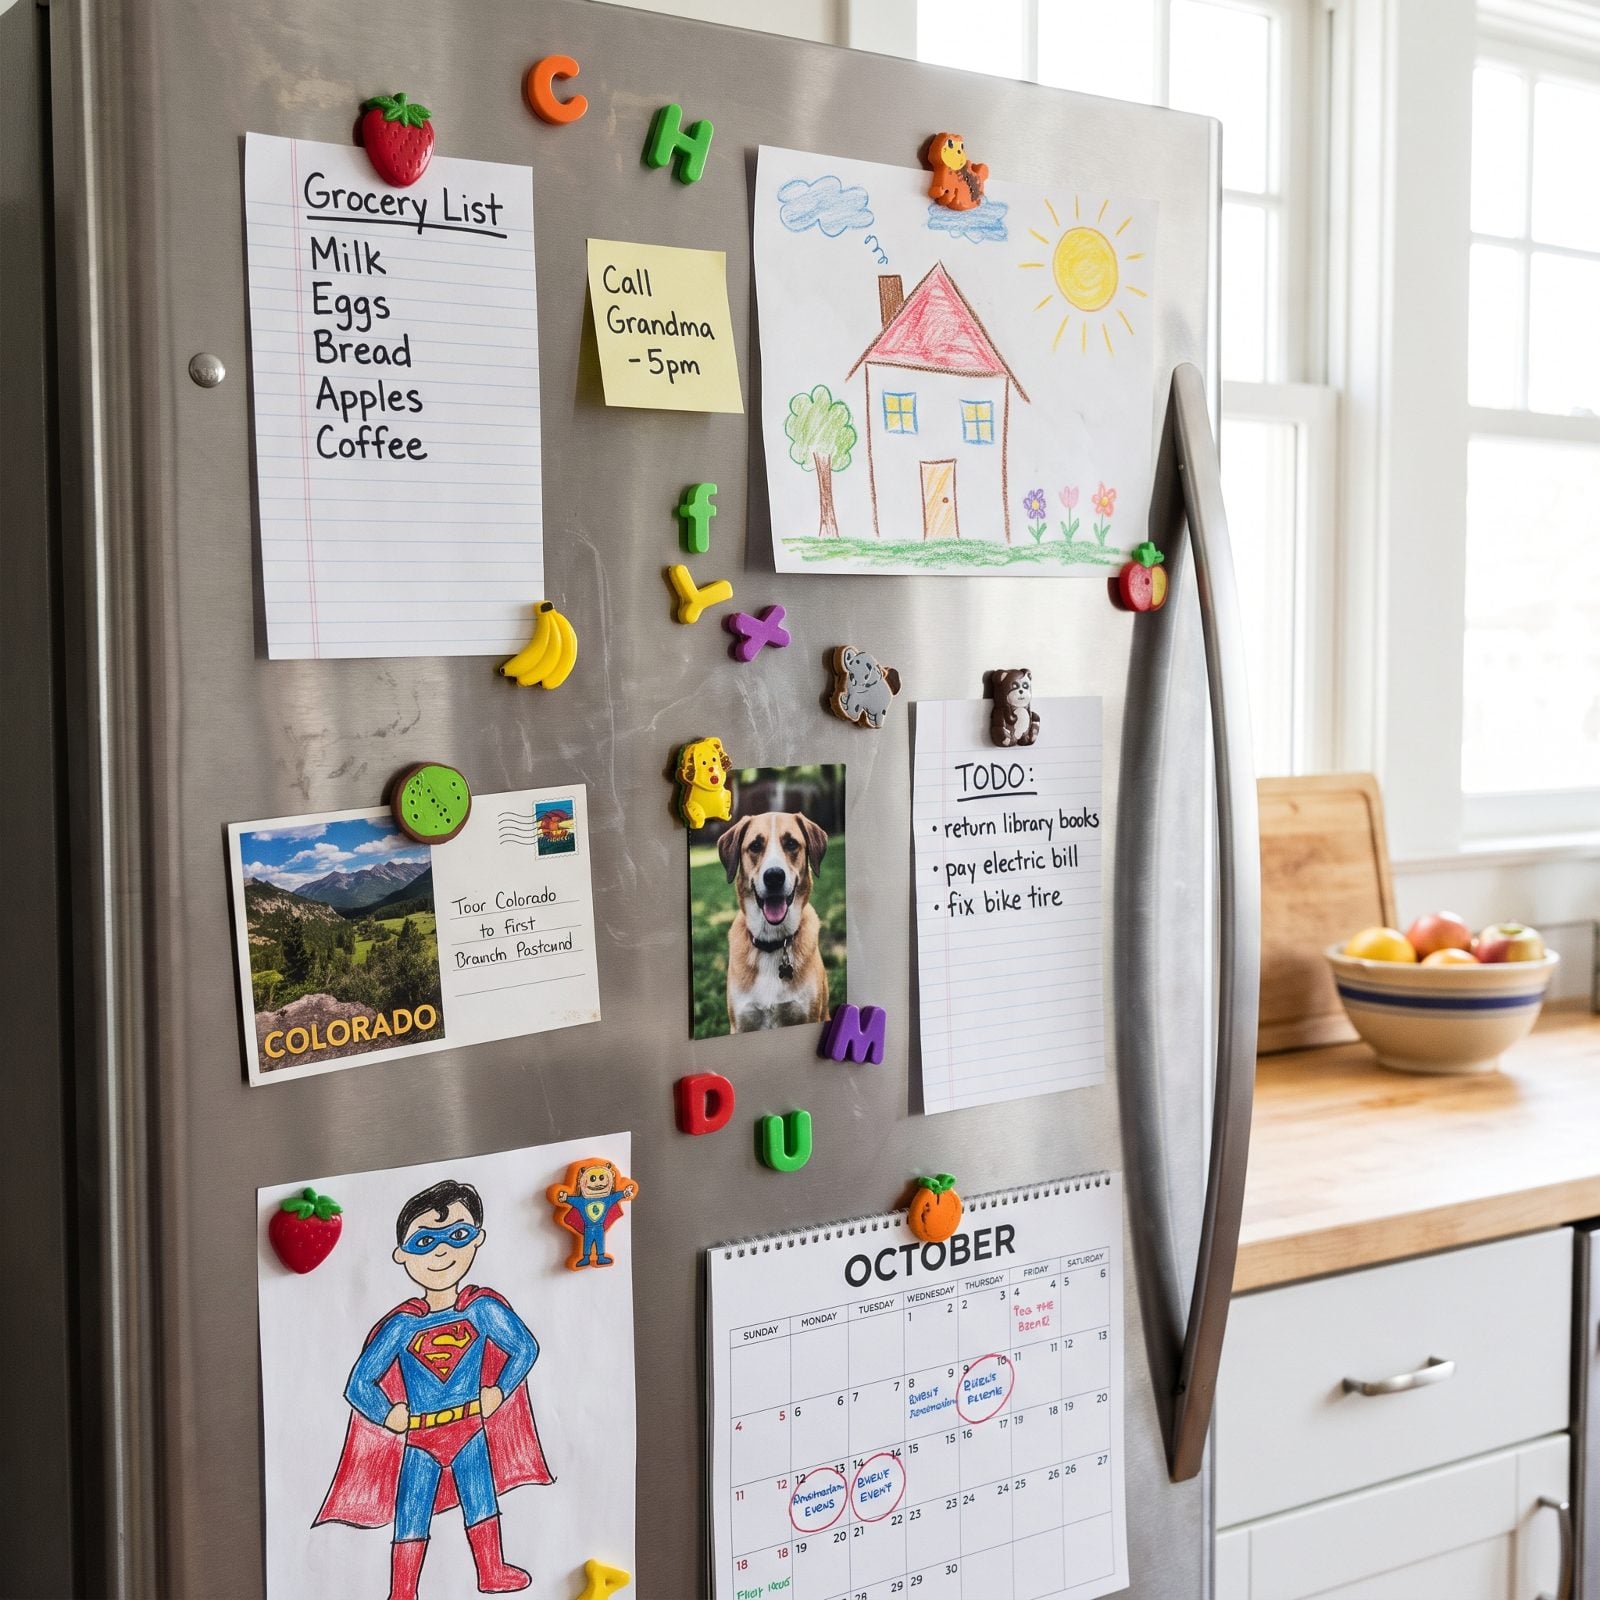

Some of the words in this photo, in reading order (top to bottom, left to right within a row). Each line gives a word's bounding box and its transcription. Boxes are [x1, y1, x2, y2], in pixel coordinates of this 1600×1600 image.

[527, 55, 588, 125] C
[648, 103, 714, 186] H
[304, 172, 428, 234] Grocery
[443, 188, 504, 226] List
[310, 236, 387, 276] Milk
[603, 265, 653, 297] Call
[312, 281, 391, 333] Eggs
[606, 305, 716, 340] Grandma
[313, 329, 412, 368] Bread
[315, 376, 424, 423] Apples
[316, 424, 429, 461] Coffee
[955, 762, 1034, 792] TODO:
[944, 816, 996, 838] return
[1003, 812, 1054, 841] library
[1059, 806, 1100, 829] books
[946, 862, 976, 887] pay
[983, 850, 1046, 875] electric
[1051, 844, 1079, 869] bill
[495, 885, 557, 909] Colorado
[947, 891, 975, 917] fix
[984, 888, 1022, 914] bike
[1027, 885, 1063, 909] tire
[480, 923, 495, 939] to
[264, 1004, 437, 1059] COLORADO
[825, 1003, 886, 1065] M
[678, 1073, 735, 1136] D
[763, 1109, 812, 1172] U
[845, 1224, 1016, 1288] OCTOBER
[1100, 1269, 1106, 1278] 6
[1050, 1279, 1056, 1288] 4
[1064, 1277, 1070, 1286] 5
[743, 1325, 779, 1340] SUNDAY
[801, 1312, 837, 1327] MONDAY
[859, 1299, 894, 1314] TUESDAY
[907, 1286, 955, 1303] WEDNESDAY
[965, 1275, 1004, 1290] THURSDAY
[1023, 1265, 1049, 1277] FRIDAY
[1067, 1253, 1104, 1268] SATURDAY
[1000, 1291, 1006, 1300] 3
[1014, 1288, 1020, 1296] 4
[947, 1304, 953, 1313] 2
[962, 1300, 968, 1309] 2
[908, 1312, 912, 1322] 1
[1098, 1331, 1107, 1340] 13
[1050, 1342, 1058, 1352] 11
[1064, 1339, 1073, 1349] 12
[1014, 1352, 1022, 1361] 11
[948, 1368, 954, 1378] 9
[894, 1382, 900, 1392] 7
[908, 1379, 915, 1388] 8
[837, 1396, 844, 1406] 6
[852, 1392, 859, 1402] 7
[1096, 1393, 1108, 1404] 20
[794, 1407, 801, 1417] 6
[1064, 1402, 1074, 1412] 19
[779, 1411, 786, 1421] 5
[735, 1422, 742, 1431] 4
[999, 1419, 1008, 1429] 17
[945, 1434, 956, 1444] 15
[962, 1429, 973, 1440] 16
[908, 1444, 919, 1454] 15
[1097, 1455, 1108, 1466] 27
[835, 1464, 845, 1474] 13
[1048, 1469, 1060, 1480] 26
[1065, 1464, 1076, 1475] 26
[776, 1479, 788, 1490] 12
[997, 1484, 1010, 1495] 24
[1014, 1479, 1026, 1490] 25
[736, 1490, 744, 1500] 11
[962, 1494, 976, 1506] 24
[946, 1498, 958, 1510] 23
[891, 1514, 903, 1526] 22
[909, 1509, 921, 1521] 23
[833, 1531, 847, 1544] 20
[854, 1526, 864, 1538] 21
[777, 1547, 789, 1558] 18
[795, 1542, 807, 1554] 19
[736, 1559, 748, 1571] 18
[945, 1564, 958, 1576] 30
[891, 1580, 904, 1593] 29
[910, 1575, 923, 1587] 29
